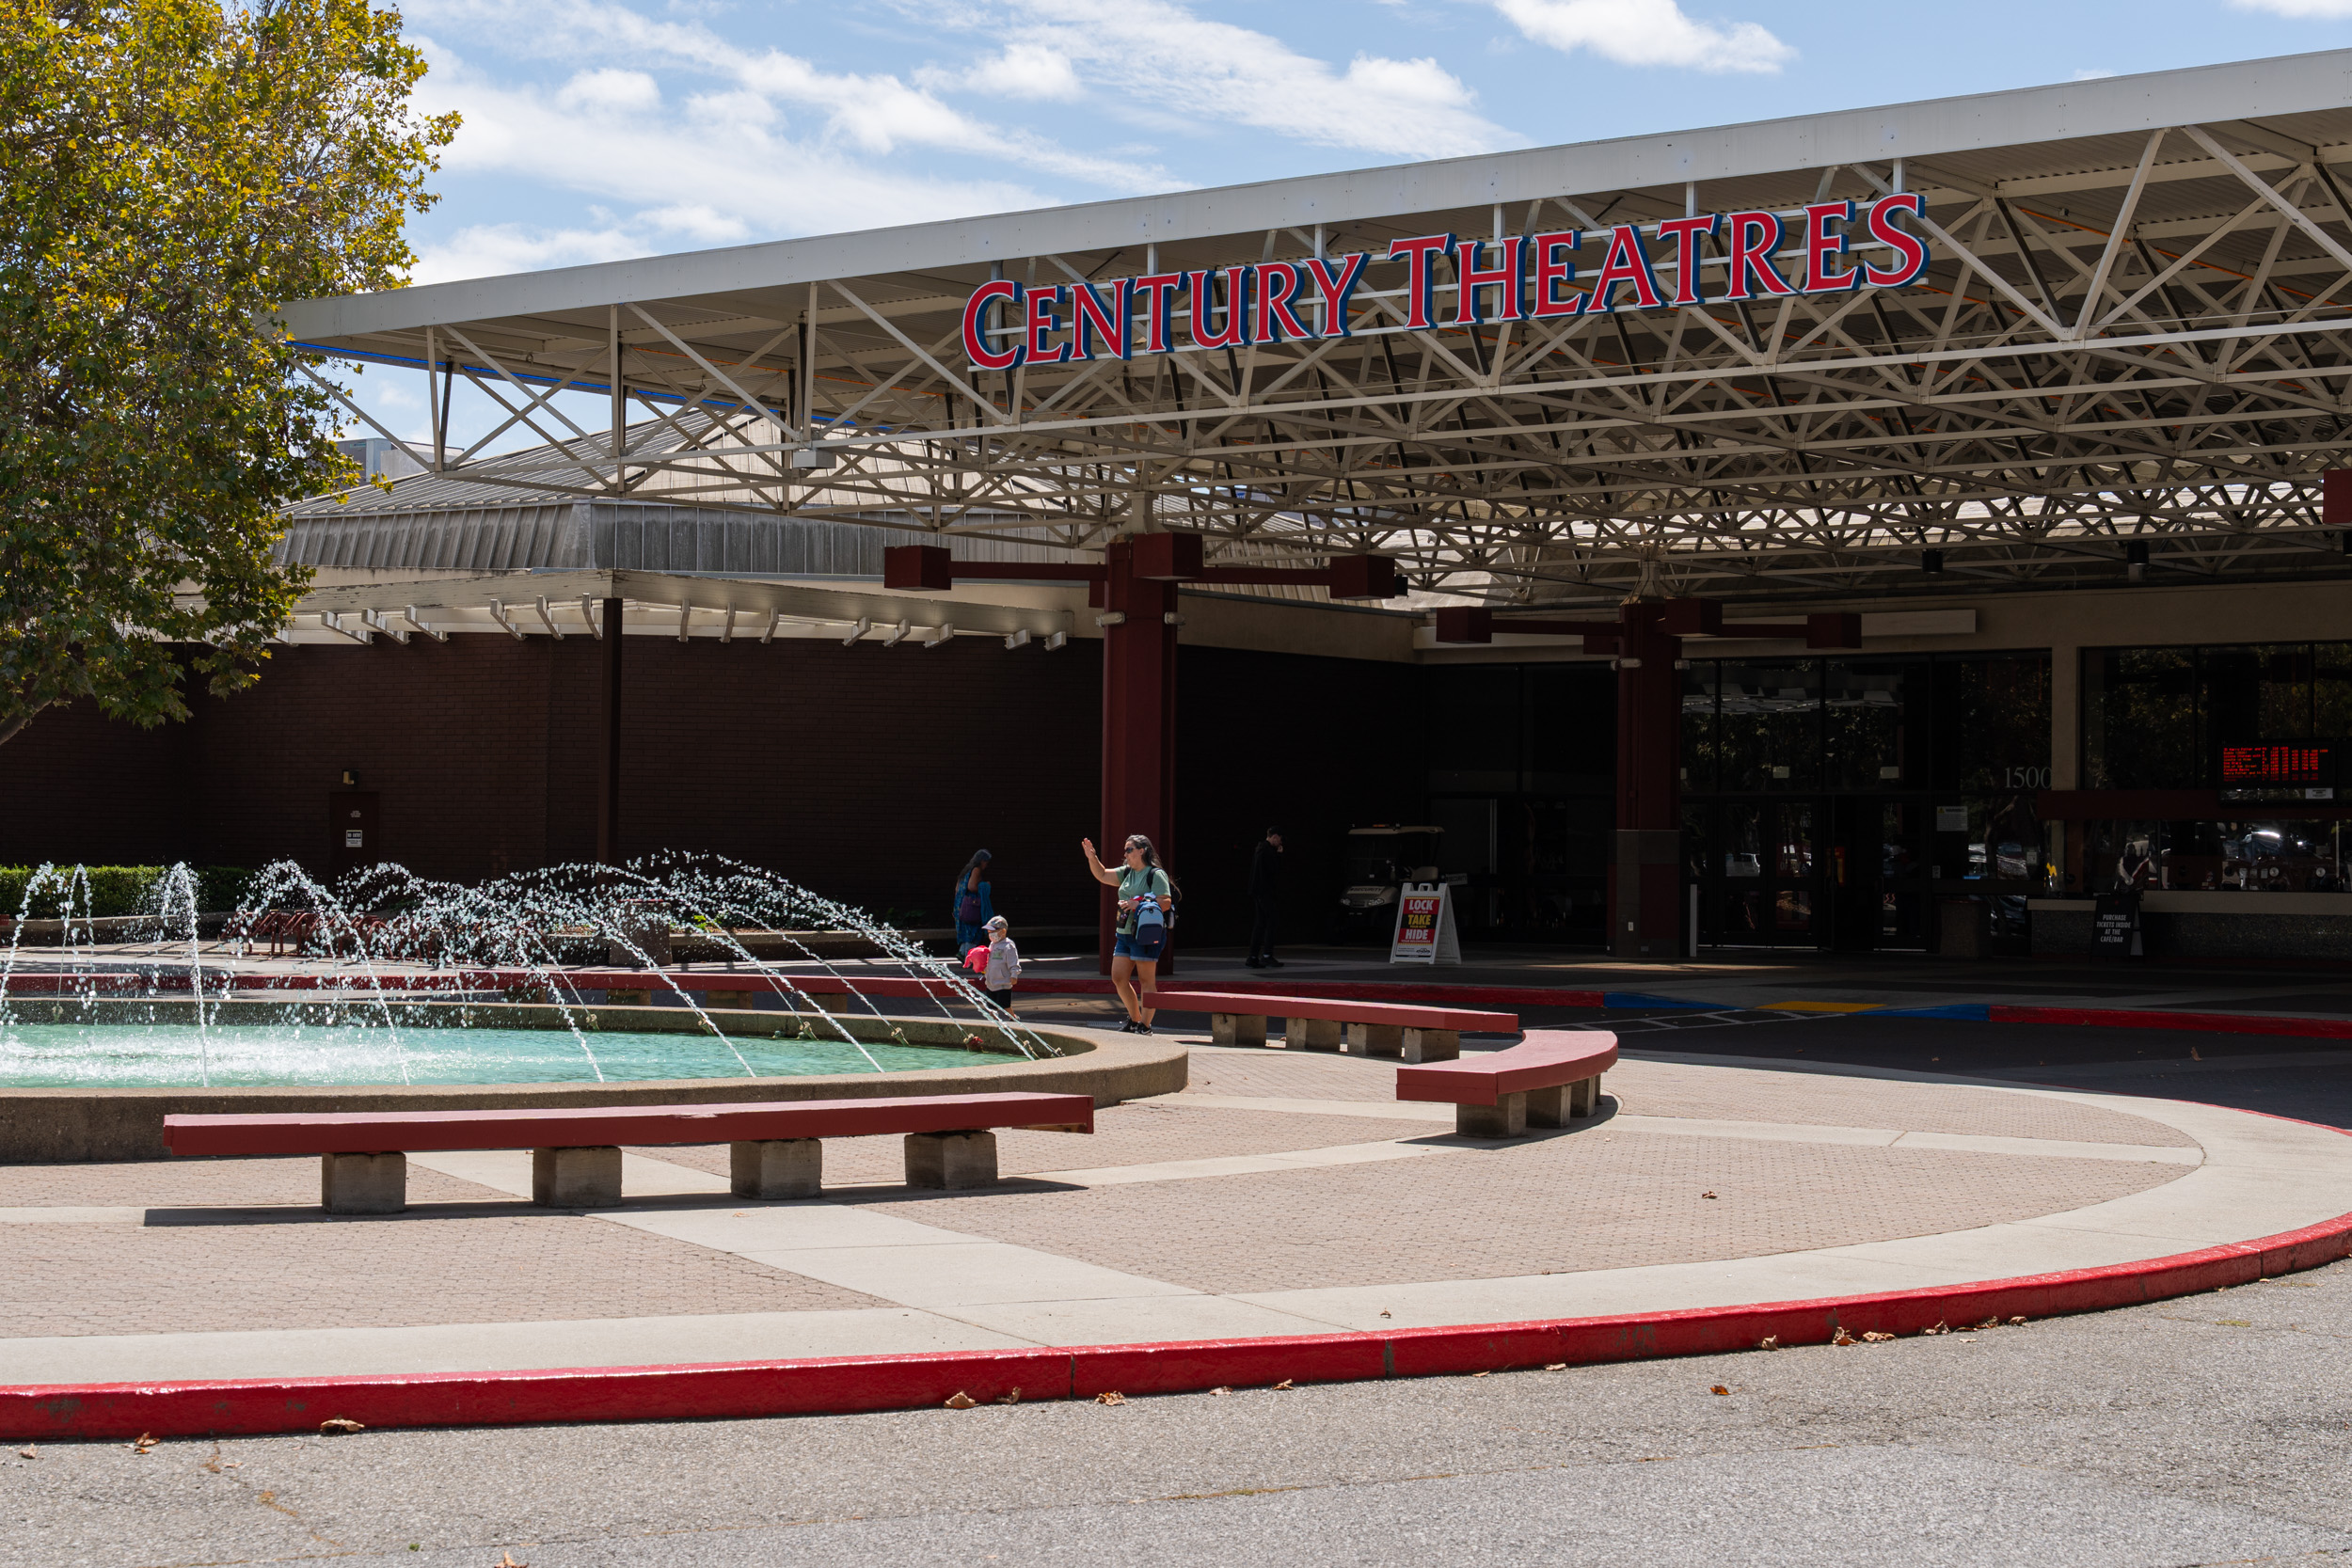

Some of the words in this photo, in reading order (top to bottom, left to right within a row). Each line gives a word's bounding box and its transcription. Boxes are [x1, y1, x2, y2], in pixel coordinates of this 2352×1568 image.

[961, 252, 1372, 370] CENTURY
[1388, 192, 1931, 330] THEATRES
[2004, 767, 2052, 789] 1500
[1409, 899, 1434, 911] LOCK
[1407, 914, 1432, 926] TAKE
[1405, 928, 1429, 940] HIDE
